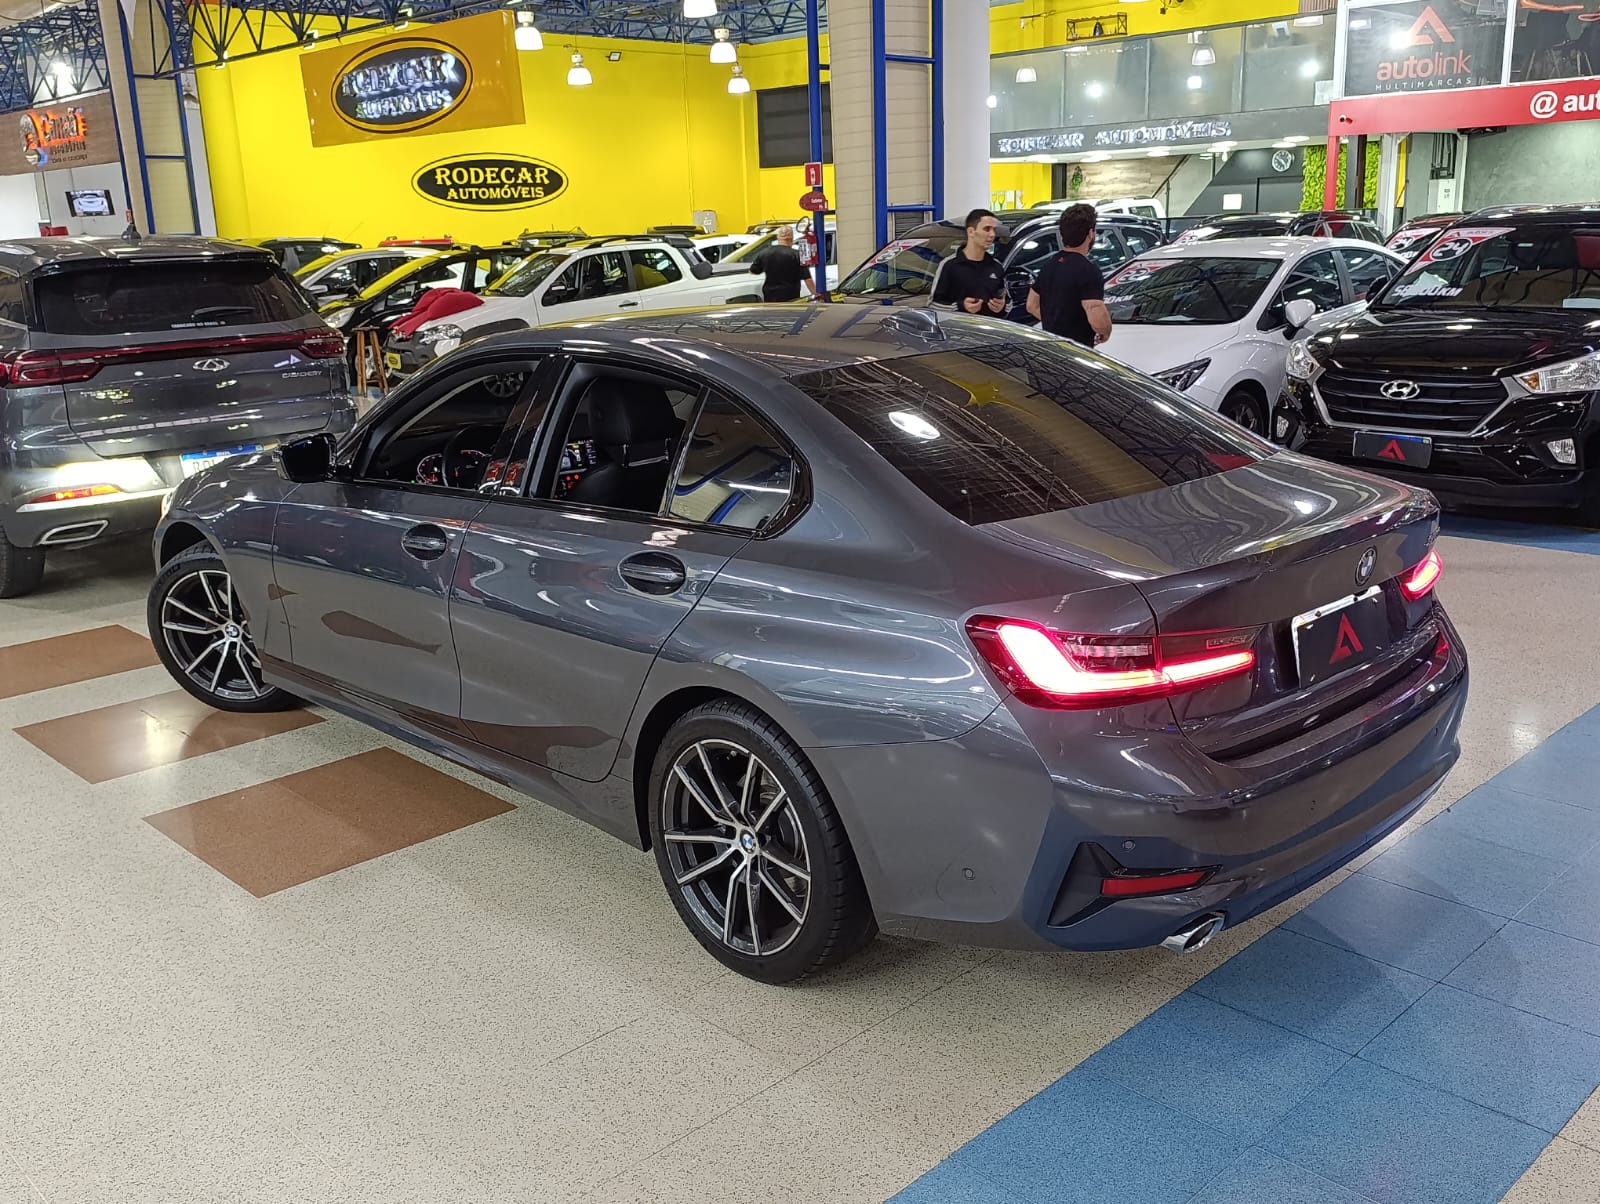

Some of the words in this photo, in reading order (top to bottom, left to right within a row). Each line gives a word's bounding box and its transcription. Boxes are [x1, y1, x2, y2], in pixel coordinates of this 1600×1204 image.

[1376, 49, 1472, 81] autolink
[1375, 77, 1472, 92] MULTIMARCAS
[434, 167, 550, 186] RODECAR
[446, 184, 545, 200] AUTOMÓVEIS
[1432, 242, 1468, 257] 24
